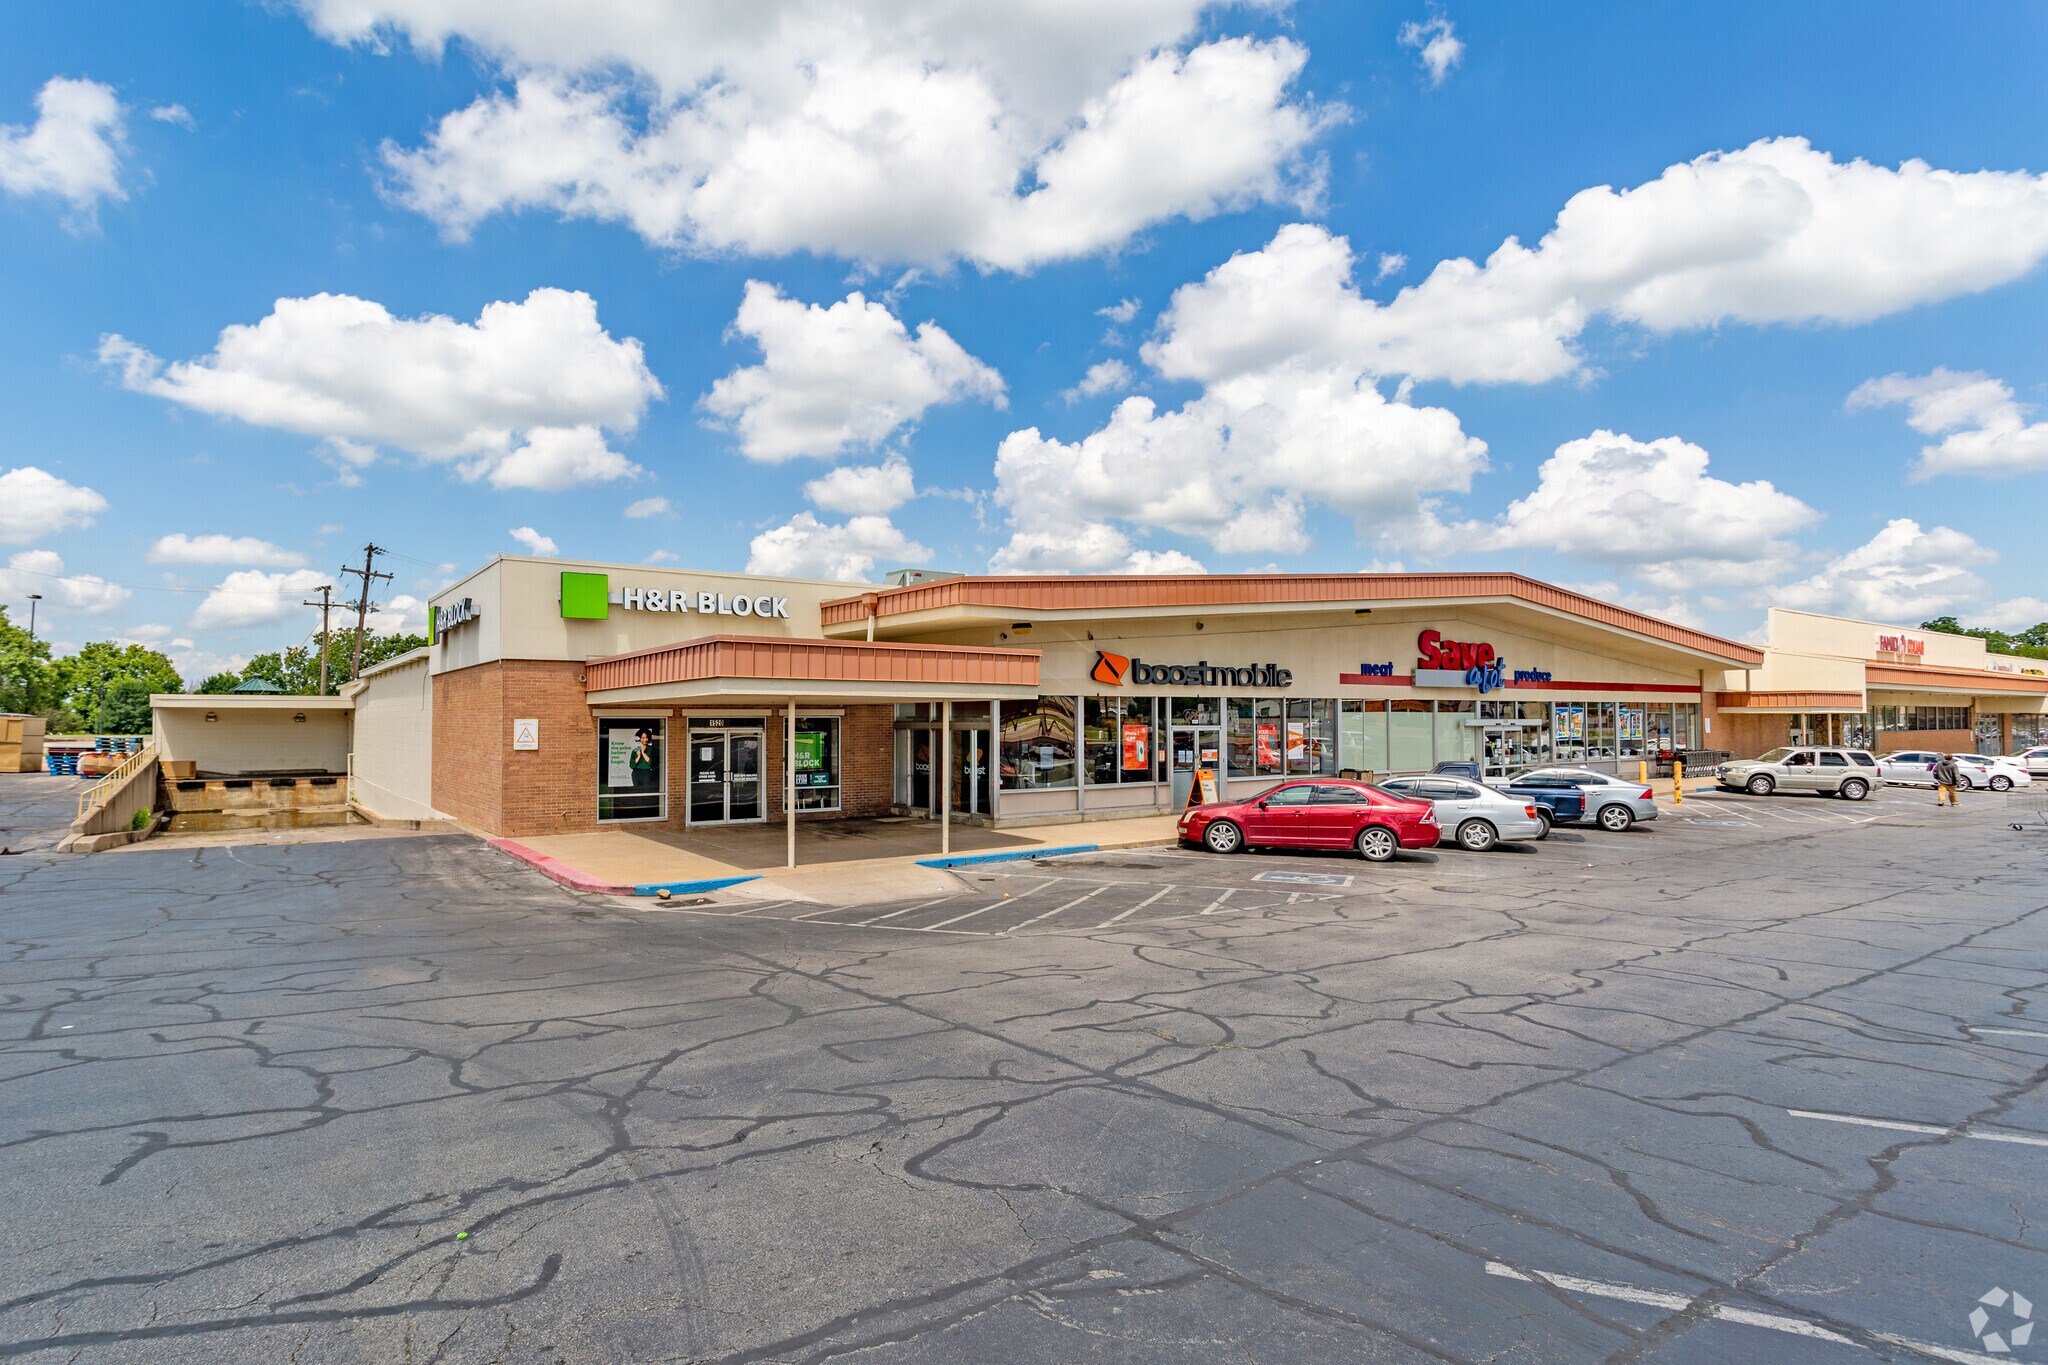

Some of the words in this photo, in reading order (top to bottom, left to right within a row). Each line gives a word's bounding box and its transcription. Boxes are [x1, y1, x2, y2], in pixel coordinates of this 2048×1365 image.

[622, 586, 688, 613] H&R
[697, 591, 790, 619] BLOCK
[447, 597, 471, 628] BLOCK
[1417, 629, 1495, 671] Save
[1360, 661, 1393, 676] meat
[1514, 667, 1552, 686] produce
[794, 759, 820, 767] BLOCK
[915, 762, 930, 771] boos
